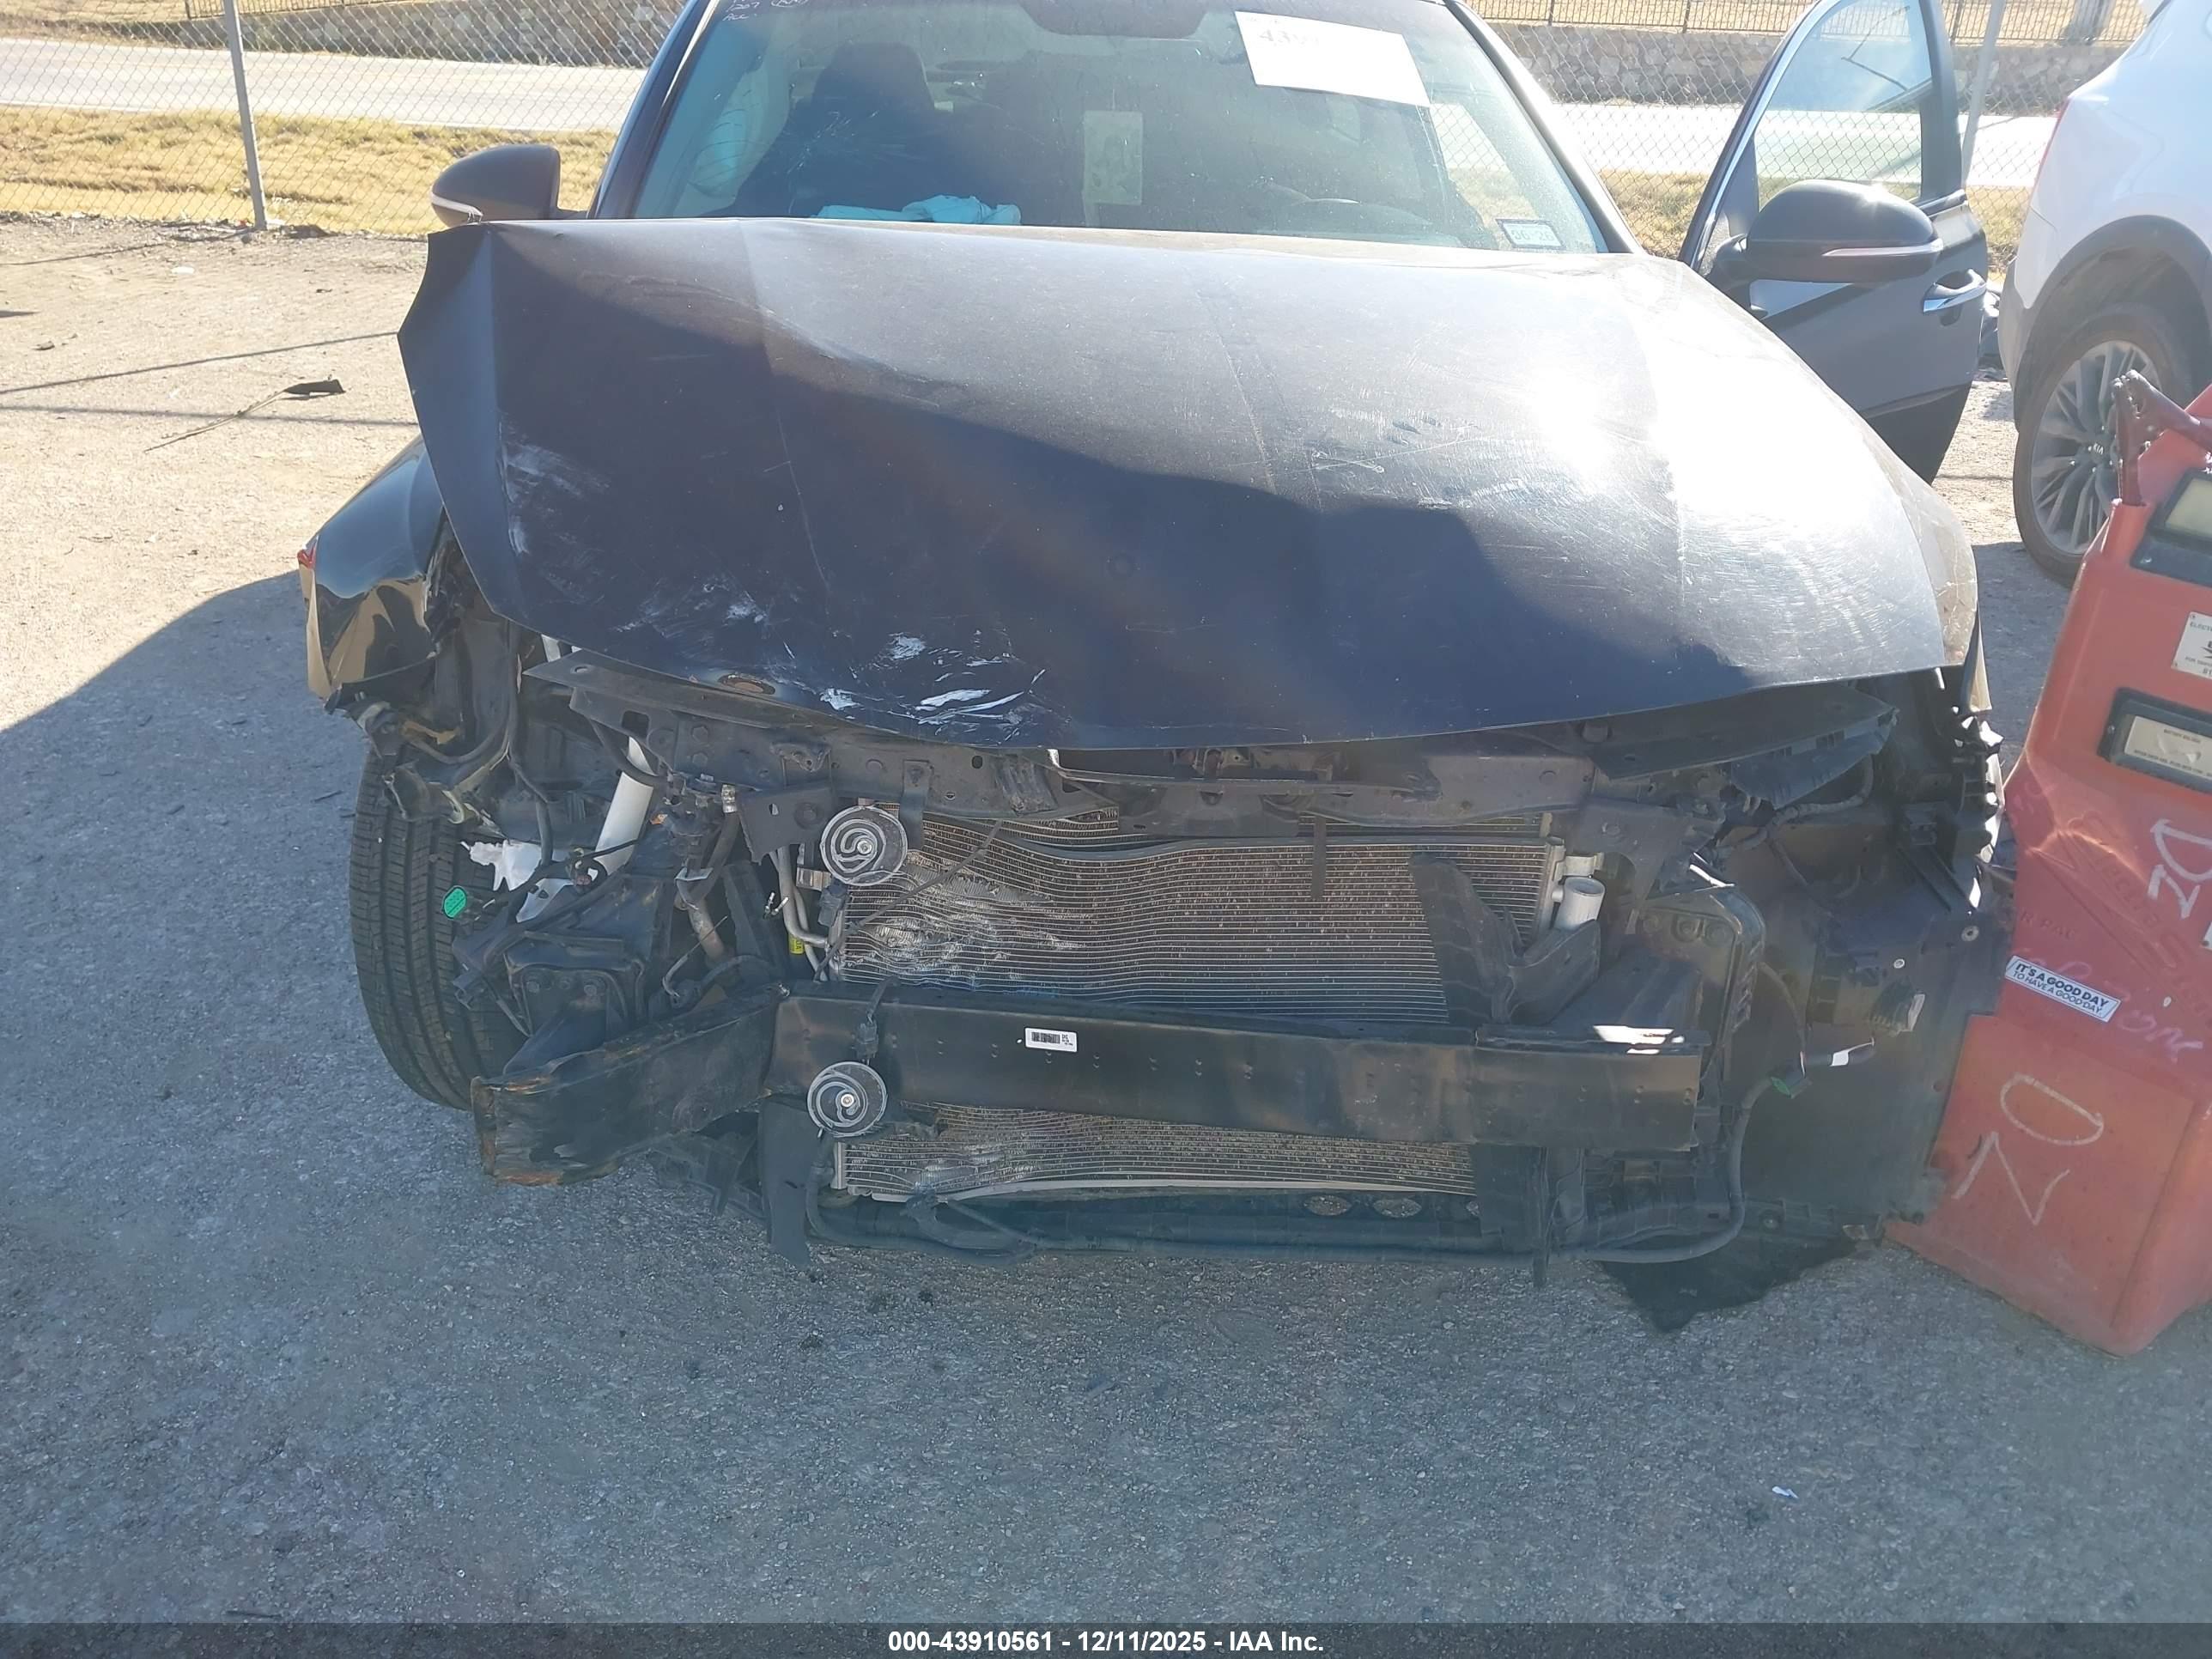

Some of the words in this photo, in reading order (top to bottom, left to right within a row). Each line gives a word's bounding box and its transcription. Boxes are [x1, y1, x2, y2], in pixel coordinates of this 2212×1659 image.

[2013, 971, 2025, 980] TO
[2025, 977, 2047, 991] HAVE
[2055, 989, 2082, 1005] GOOD
[2015, 963, 2037, 977] IT'S
[2036, 973, 2045, 981] A
[2046, 976, 2081, 996] GOOD
[2081, 992, 2109, 1007] DAY
